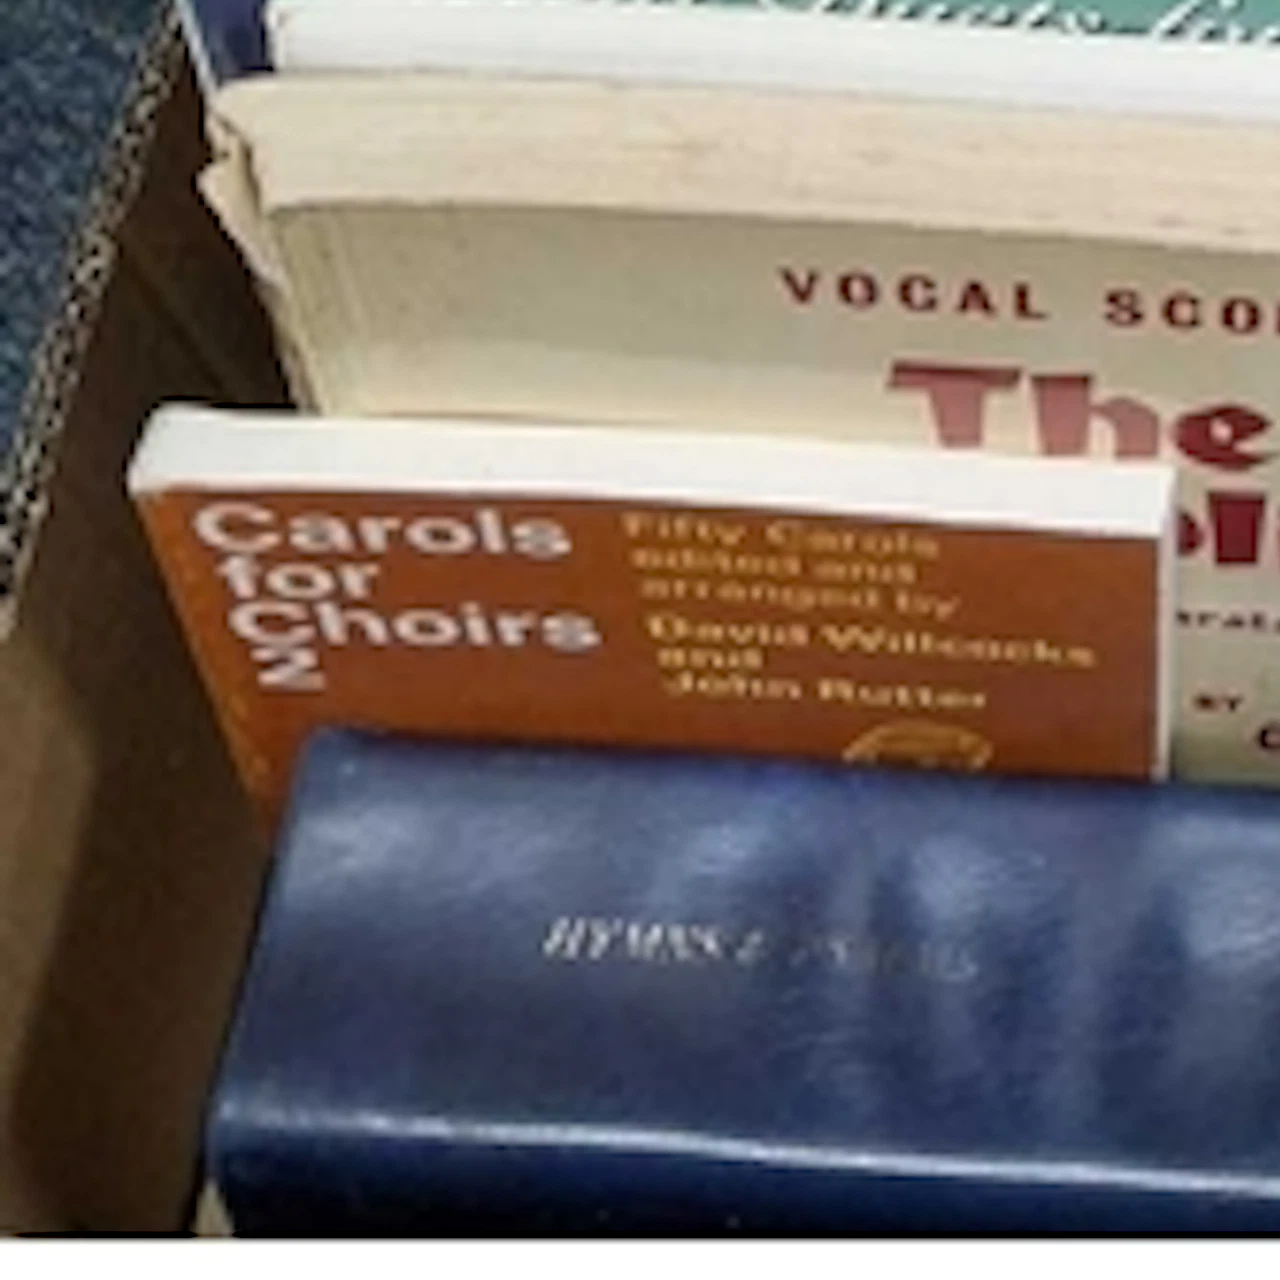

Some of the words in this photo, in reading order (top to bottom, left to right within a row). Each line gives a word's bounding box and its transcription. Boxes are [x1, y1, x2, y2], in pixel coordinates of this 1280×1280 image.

[779, 267, 1051, 321] VOCAL
[194, 501, 573, 558] Carols
[621, 511, 745, 546] Fifty
[765, 519, 940, 557] Carols
[217, 553, 381, 600] for
[812, 559, 918, 584] and
[641, 578, 881, 612] arranged
[896, 589, 962, 623] by
[227, 599, 602, 653] Choirs
[645, 614, 810, 647] David
[657, 646, 764, 670] and
[663, 672, 802, 700] John
[817, 677, 988, 710] Rutter
